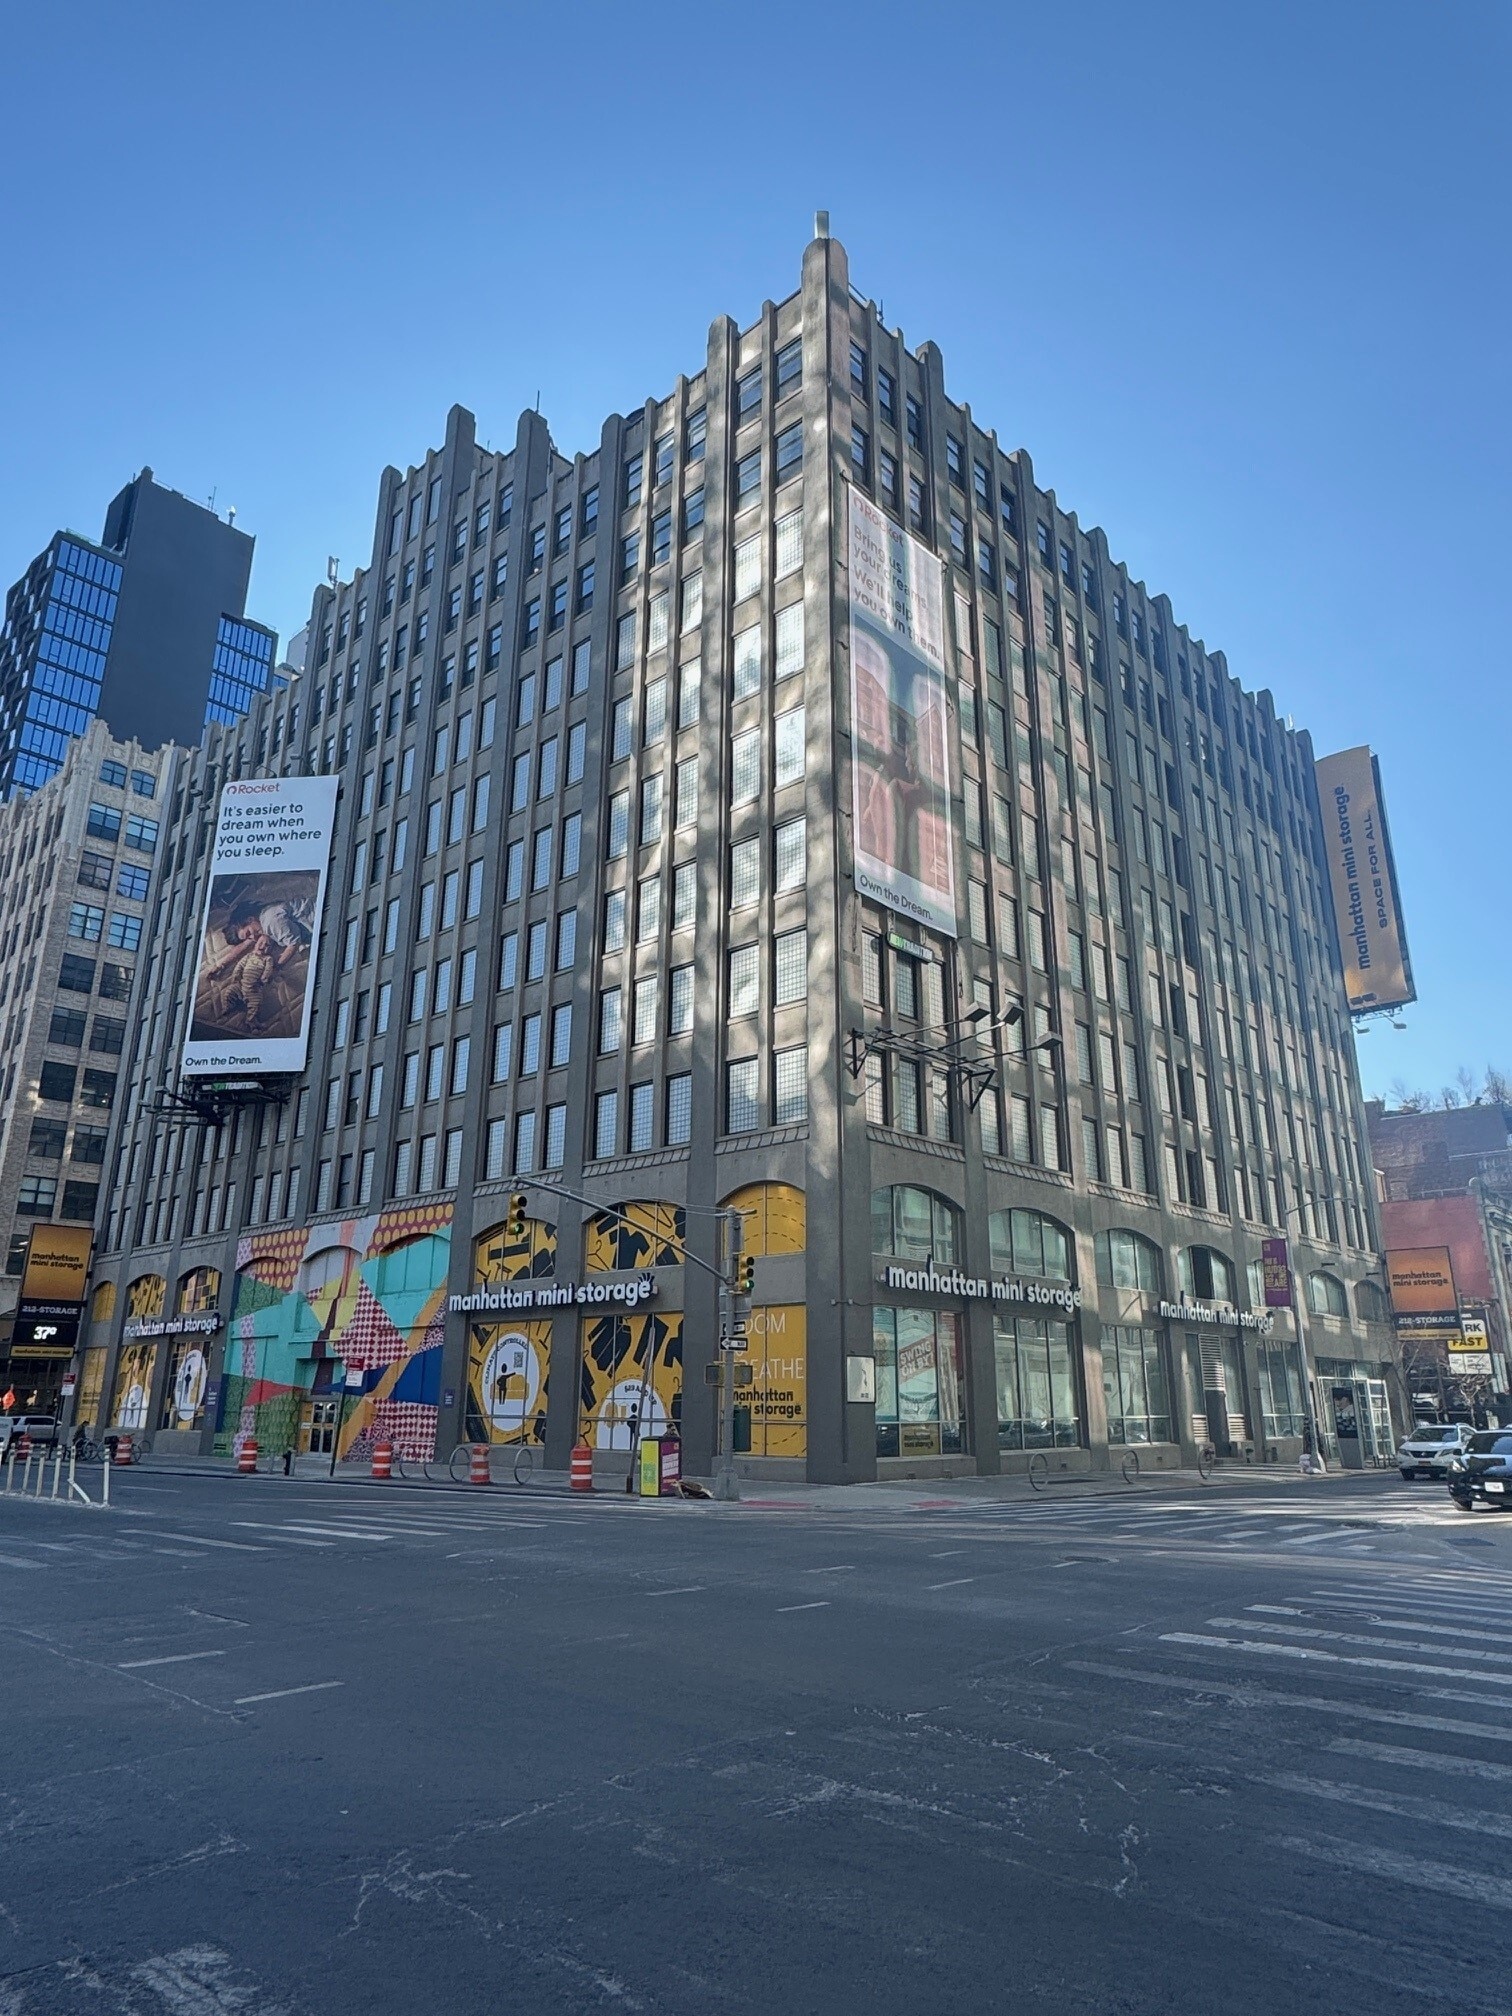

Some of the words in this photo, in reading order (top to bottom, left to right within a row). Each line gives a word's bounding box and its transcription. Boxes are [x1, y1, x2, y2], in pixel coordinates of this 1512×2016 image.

[864, 504, 903, 547] Rocket
[854, 525, 886, 563] Bring
[890, 557, 903, 574] us
[854, 543, 881, 573] your
[854, 565, 884, 600] We'll
[885, 590, 913, 621] help
[854, 587, 877, 612] you
[879, 607, 906, 635] own
[238, 783, 281, 794] Rocket
[223, 805, 243, 817] It's
[245, 803, 286, 816] easier
[289, 803, 304, 813] to
[1333, 785, 1352, 845] storage
[221, 820, 263, 830] dream
[267, 817, 304, 827] when
[1363, 809, 1375, 840] ALL.
[219, 834, 243, 846] you
[246, 832, 275, 842] own
[278, 830, 322, 840] where
[217, 847, 241, 859] you
[244, 845, 285, 858] sleep.
[1367, 844, 1379, 875] FOR
[1341, 846, 1357, 880] mini
[860, 875, 883, 896] Own
[884, 886, 900, 905] the
[901, 895, 934, 920] Dream.
[1374, 878, 1388, 929] SPACE
[1348, 882, 1371, 970] manhattan
[185, 1057, 208, 1066] Own
[210, 1057, 227, 1066] the
[228, 1056, 262, 1065] Dream.
[31, 1250, 79, 1263] manhattan
[50, 1259, 83, 1271] storage
[889, 1258, 988, 1297] manhattan
[991, 1276, 1023, 1301] mini
[1027, 1281, 1082, 1312] storage
[1392, 1271, 1442, 1280] manhattan
[1393, 1279, 1411, 1287] mini
[1413, 1278, 1449, 1287] storage
[449, 1281, 533, 1311] manhattan
[537, 1282, 573, 1306] mini
[576, 1280, 650, 1307] storage
[22, 1305, 78, 1315] 212-STORAGE
[1160, 1300, 1217, 1323] manhattan
[1219, 1306, 1239, 1326] mini
[1240, 1310, 1275, 1335] storage
[1398, 1316, 1456, 1324] 212-STORAGE
[124, 1317, 165, 1337] manhattan
[165, 1318, 183, 1332] mini
[183, 1318, 217, 1335] storage
[745, 1313, 786, 1334] OOM
[1464, 1323, 1482, 1333] RK
[1452, 1336, 1483, 1347] FAST
[900, 1340, 932, 1365] SWING
[754, 1404, 801, 1418] storage
